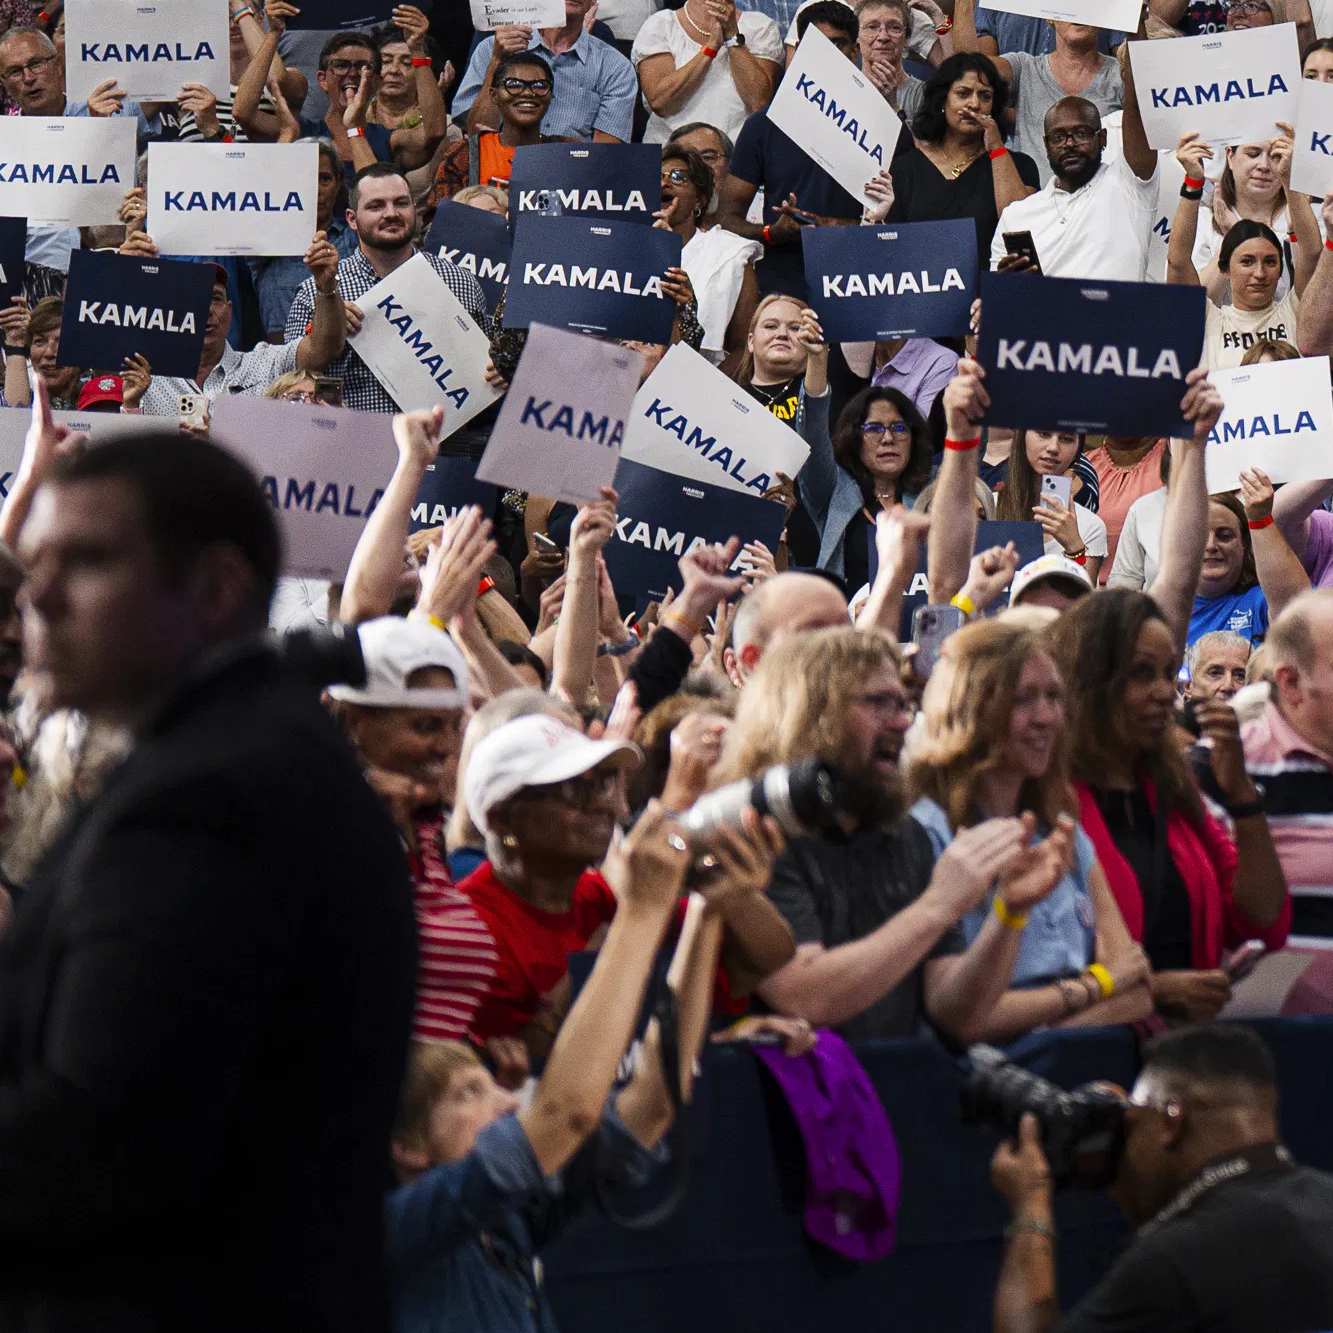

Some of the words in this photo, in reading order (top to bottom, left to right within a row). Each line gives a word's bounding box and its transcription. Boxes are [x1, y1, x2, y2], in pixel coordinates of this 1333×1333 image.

[484, 5, 509, 15] Evader
[81, 41, 214, 61] KAMALA
[1151, 73, 1288, 109] KAMALA
[795, 71, 884, 163] KAMALA
[165, 191, 303, 211] KAMALA
[523, 263, 663, 299] KAMALA
[822, 267, 965, 298] KAMALA
[79, 300, 196, 334] KAMALA
[377, 294, 469, 410] KAMALA
[996, 338, 1181, 379] KAMALA
[520, 396, 623, 447] KAMA
[1206, 411, 1316, 446] AMALA
[645, 398, 772, 494] KAMALA
